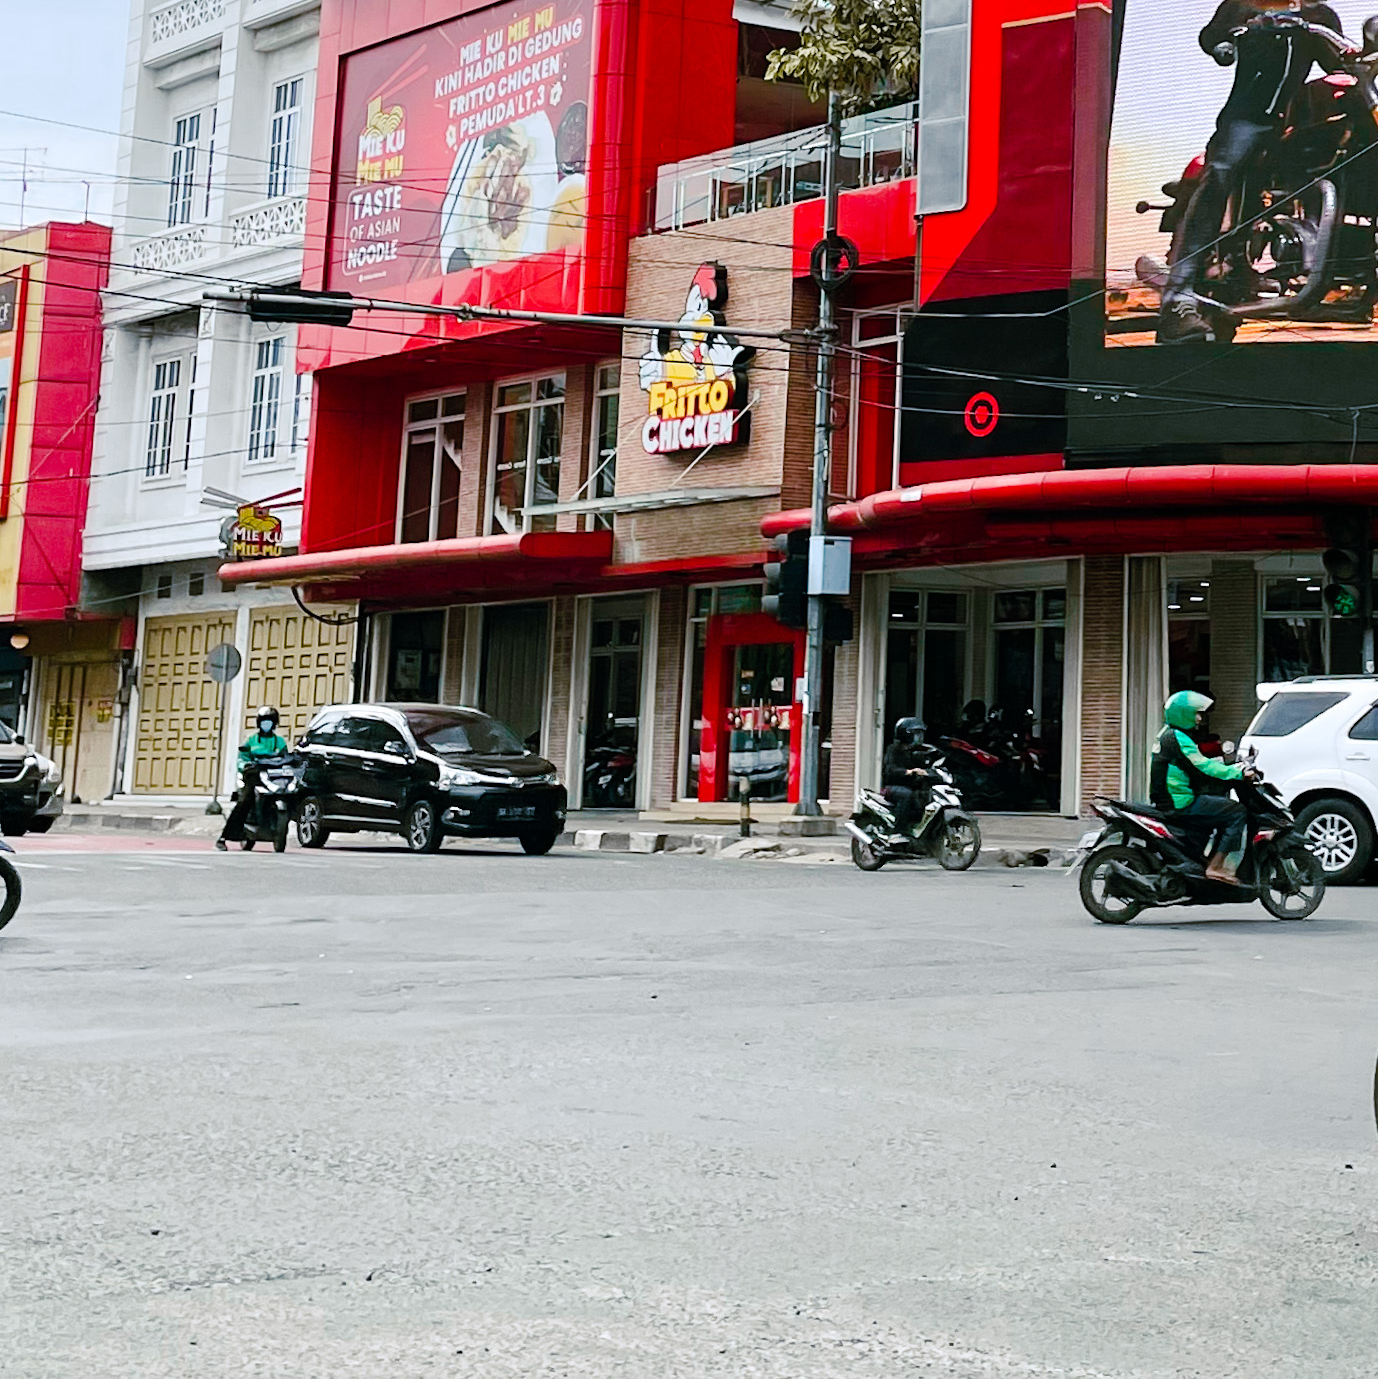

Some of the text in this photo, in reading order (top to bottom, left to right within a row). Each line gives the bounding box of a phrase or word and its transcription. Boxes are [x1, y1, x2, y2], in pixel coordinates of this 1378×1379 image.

[460, 6, 554, 67] MIE KU MIE MU
[434, 17, 583, 99] KINI HADIR DI GEDUNG
[449, 53, 560, 119] FRITTO CHICKEN
[358, 129, 405, 160] MIE KU
[383, 155, 404, 179] MU
[353, 185, 403, 220] TASTE
[350, 216, 401, 243] OF ASIAN
[347, 239, 398, 270] NOODLE
[649, 380, 730, 420] FRITTO
[641, 409, 735, 454] CHICKEN
[233, 526, 283, 543] MIE KU
[233, 542, 282, 557] MIE MU
